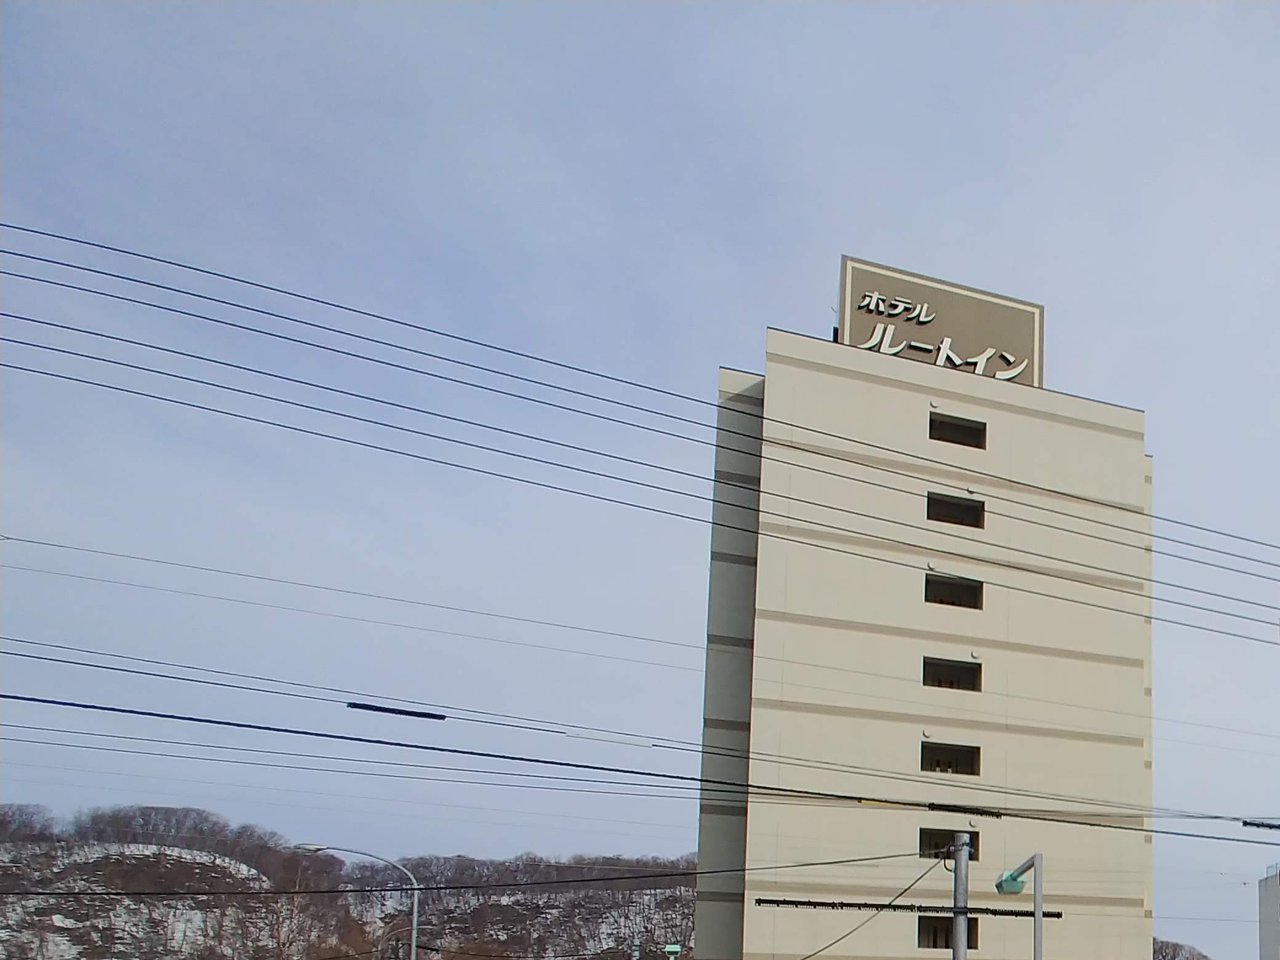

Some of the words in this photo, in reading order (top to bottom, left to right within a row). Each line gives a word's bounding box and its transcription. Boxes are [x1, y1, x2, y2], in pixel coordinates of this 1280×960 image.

[858, 291, 936, 323] ホテル
[857, 322, 1029, 380] ルートイン
